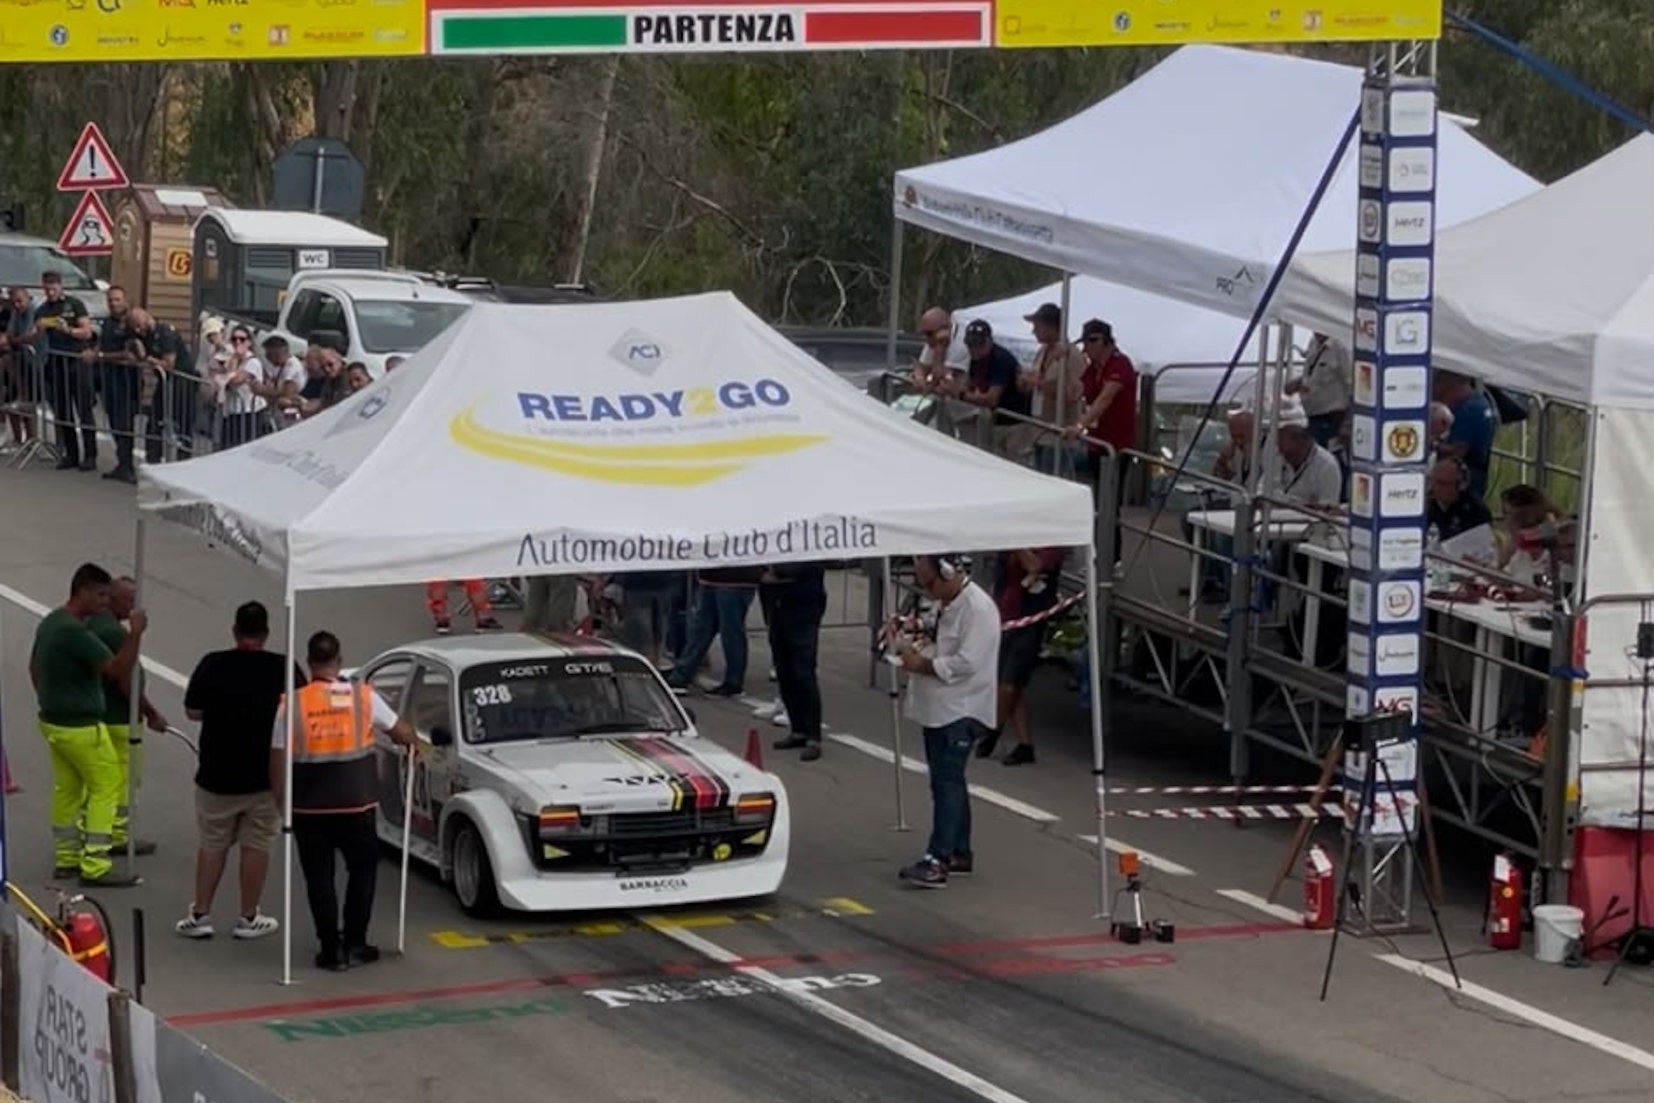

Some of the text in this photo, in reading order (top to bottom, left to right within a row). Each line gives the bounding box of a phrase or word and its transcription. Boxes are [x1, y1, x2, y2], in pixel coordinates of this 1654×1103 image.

[634, 14, 794, 43] PARTENZA
[1394, 217, 1425, 229] Hertz
[303, 254, 326, 264] WC
[516, 378, 791, 422] READY2GO
[1387, 488, 1418, 500] Hertz
[516, 532, 692, 567] Automobile
[473, 684, 513, 706] 328
